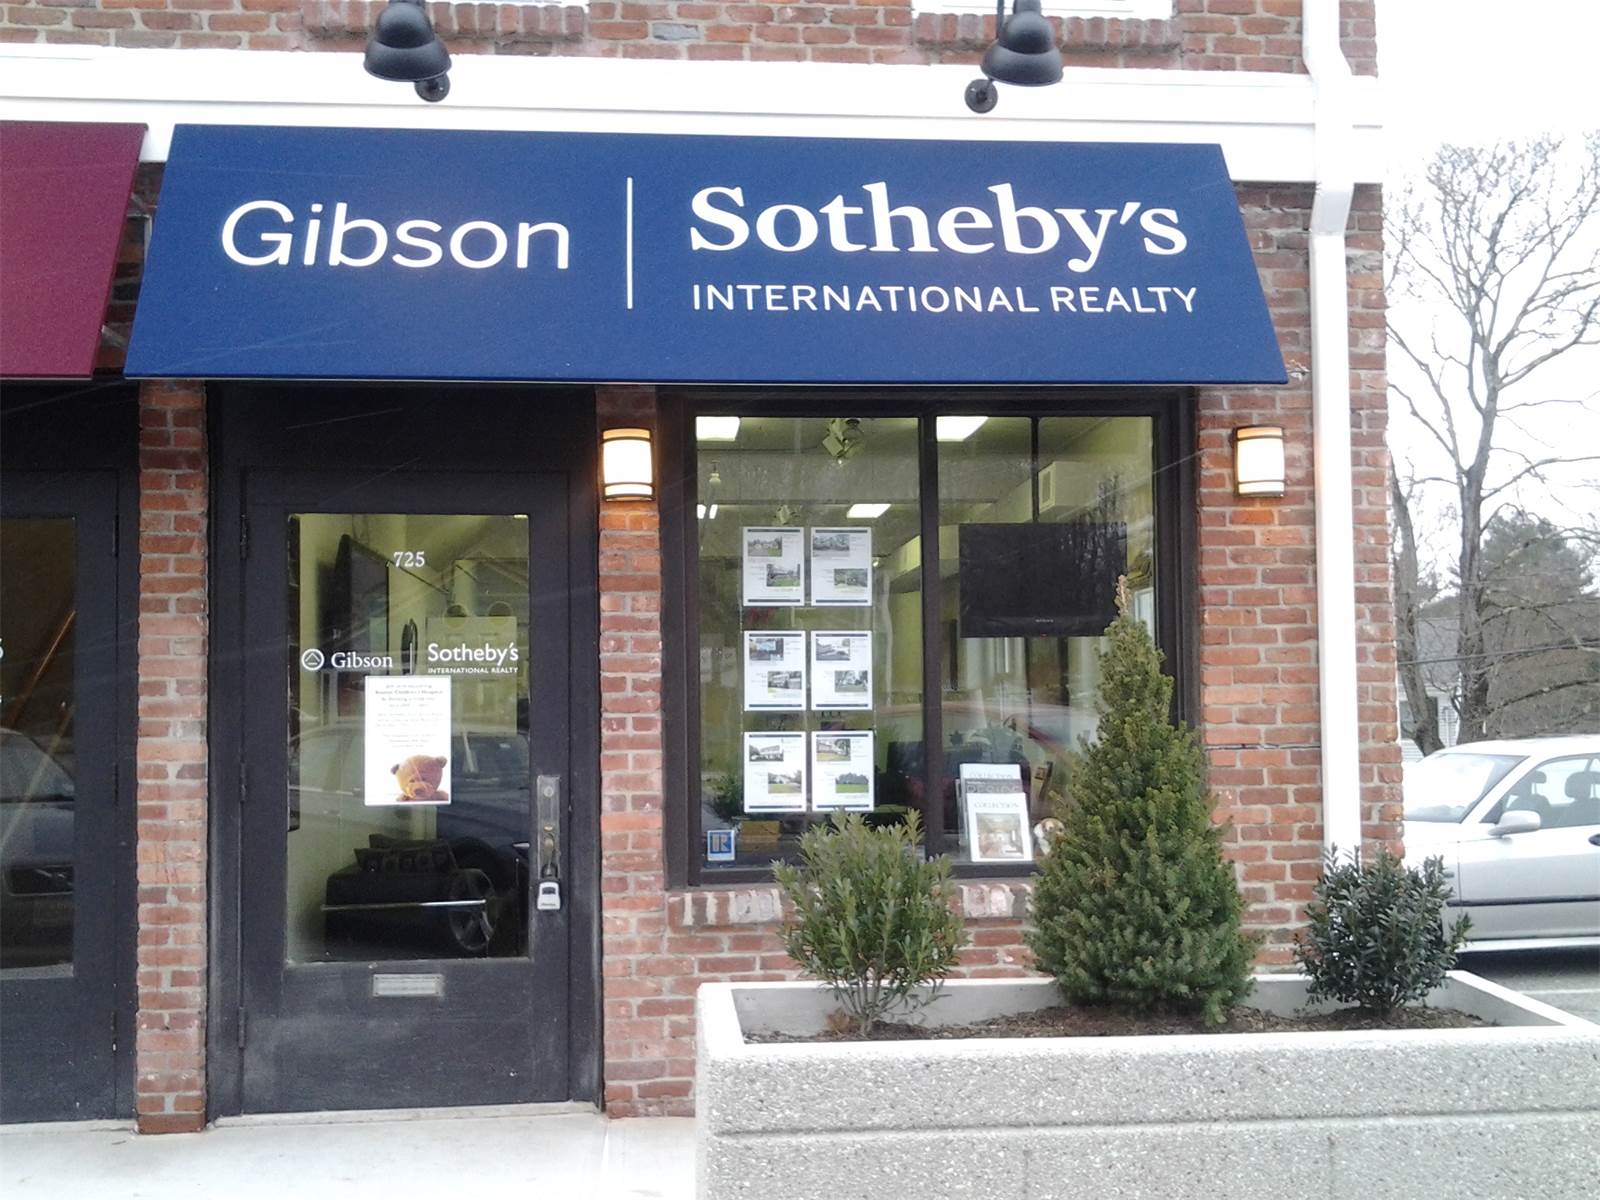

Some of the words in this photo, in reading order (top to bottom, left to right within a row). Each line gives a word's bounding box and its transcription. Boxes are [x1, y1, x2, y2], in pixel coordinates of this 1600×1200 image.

[221, 200, 569, 270] Gibson
[690, 181, 1187, 274] Sotheby's
[692, 284, 1040, 313] INTERNATIONAL
[1050, 286, 1197, 313] REALTY
[393, 551, 425, 568] 725
[331, 651, 393, 669] Gibson
[427, 643, 519, 667] Sotheby's
[427, 667, 489, 675] INTERNATIONAL
[491, 667, 519, 675] REALTY
